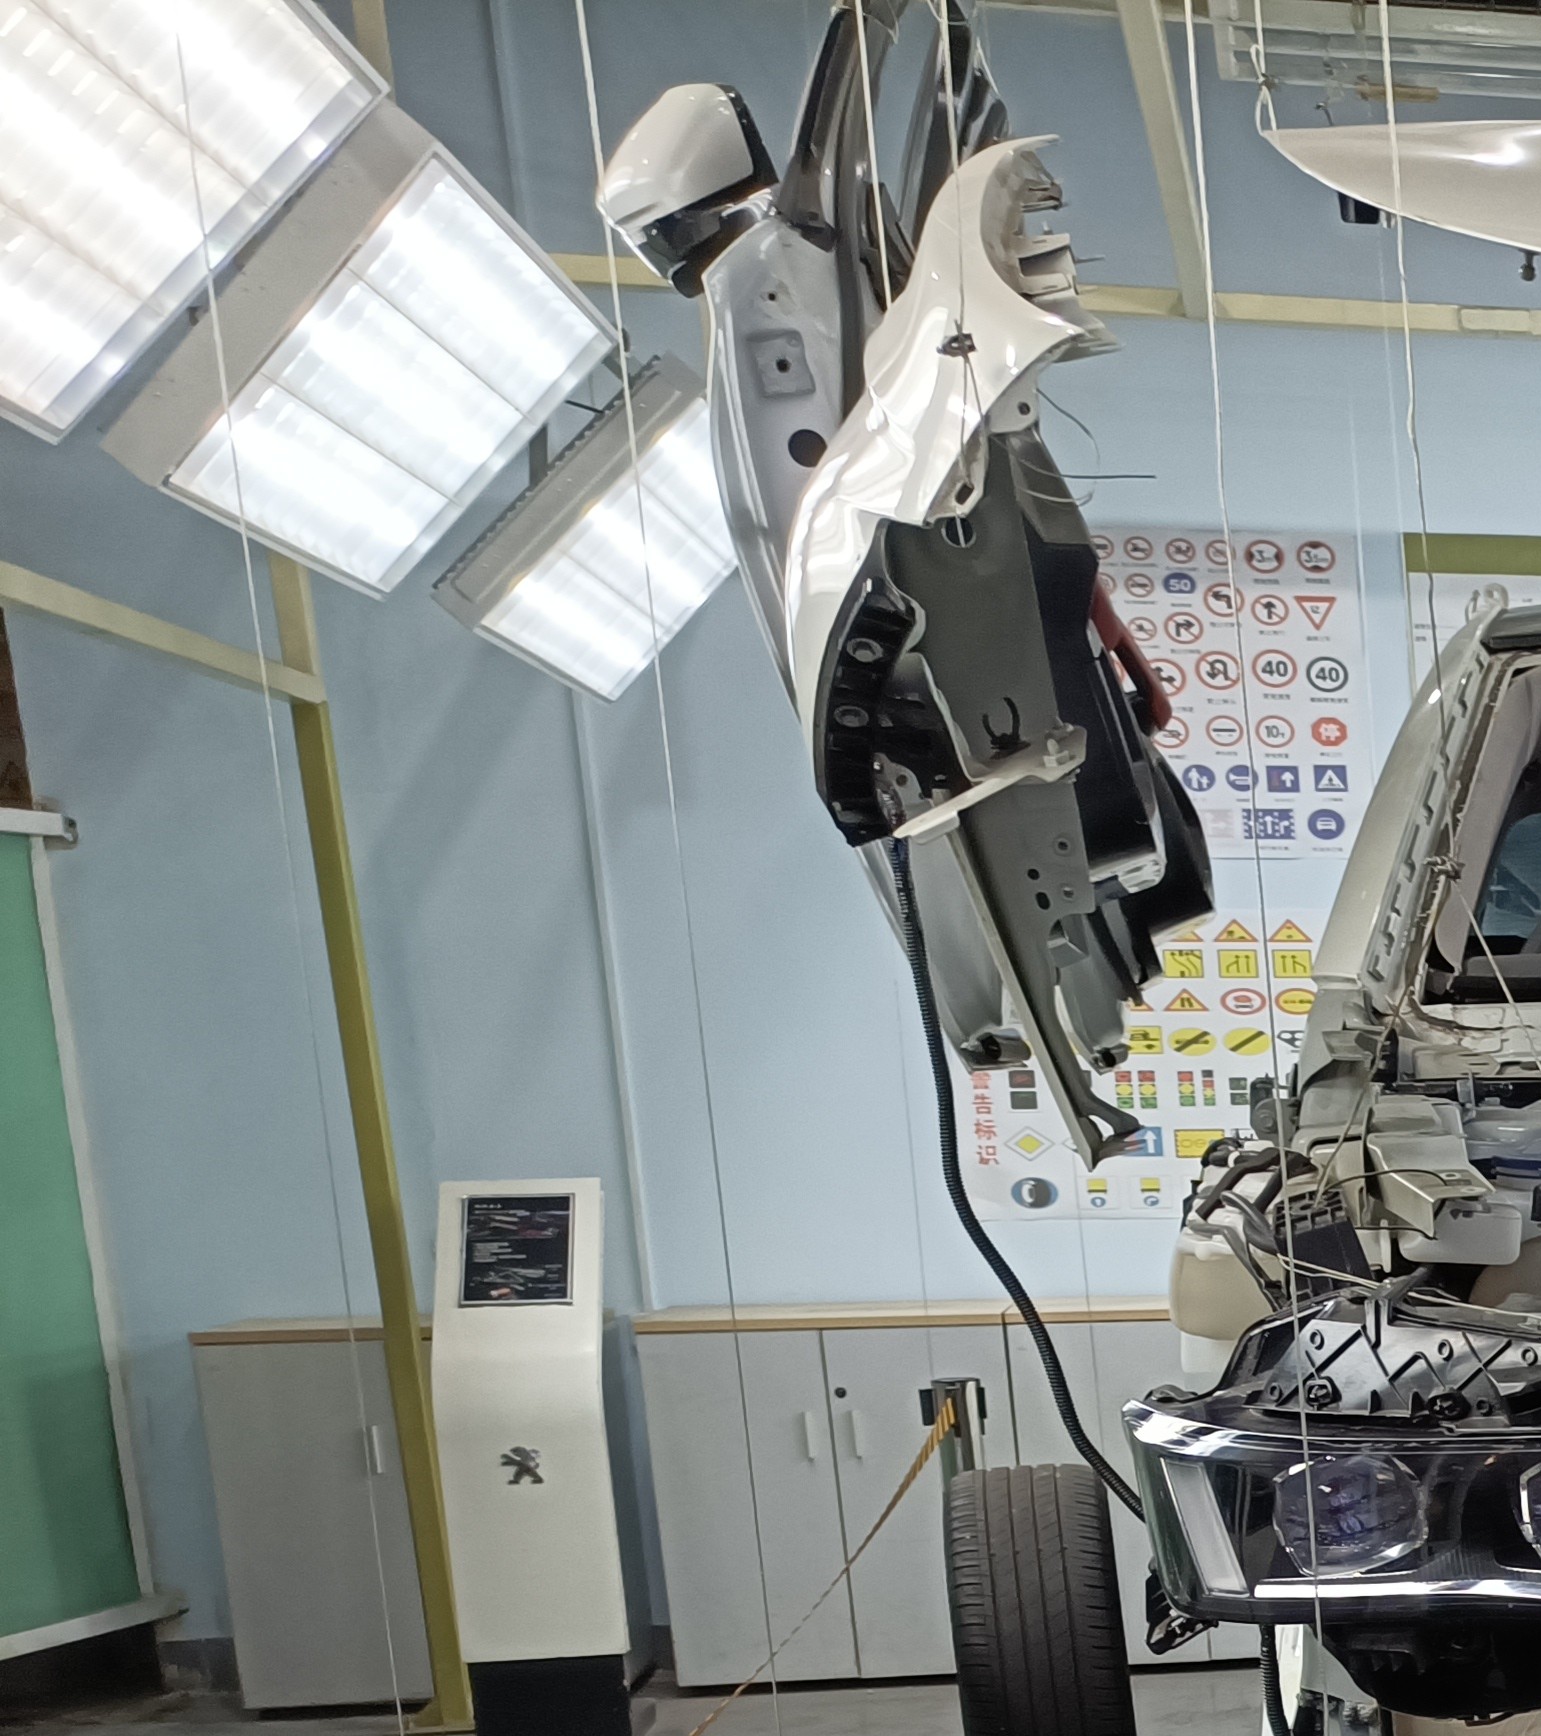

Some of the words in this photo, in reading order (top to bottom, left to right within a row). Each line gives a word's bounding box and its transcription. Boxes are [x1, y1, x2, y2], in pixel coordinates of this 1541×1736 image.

[1168, 578, 1192, 592] 50
[1261, 660, 1289, 678] 40
[1315, 666, 1341, 683] 40
